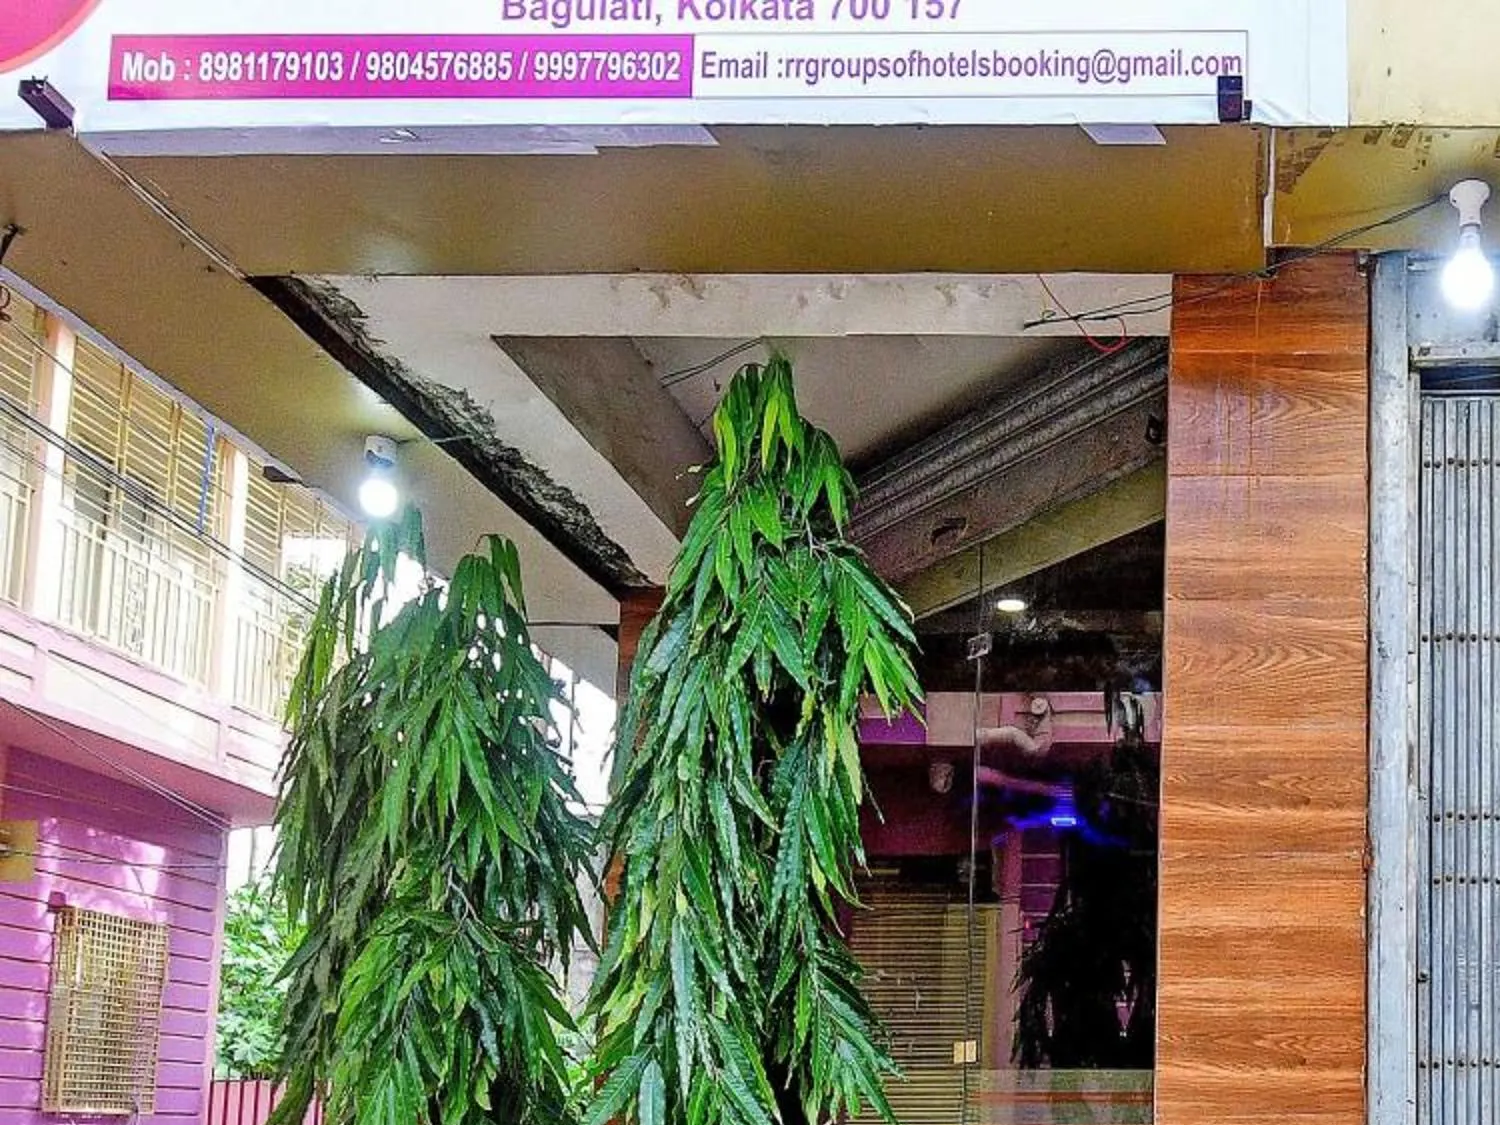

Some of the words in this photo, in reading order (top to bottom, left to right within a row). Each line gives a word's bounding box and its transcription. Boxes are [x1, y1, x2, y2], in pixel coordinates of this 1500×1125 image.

[677, 0, 815, 21] Kolkata
[831, 0, 890, 20] 700
[907, 0, 961, 20] 157
[121, 51, 176, 82] Mob
[199, 51, 344, 82] 8981179103
[365, 51, 513, 81] 9804576885
[533, 51, 681, 81] 9997796302
[701, 51, 768, 78] Email
